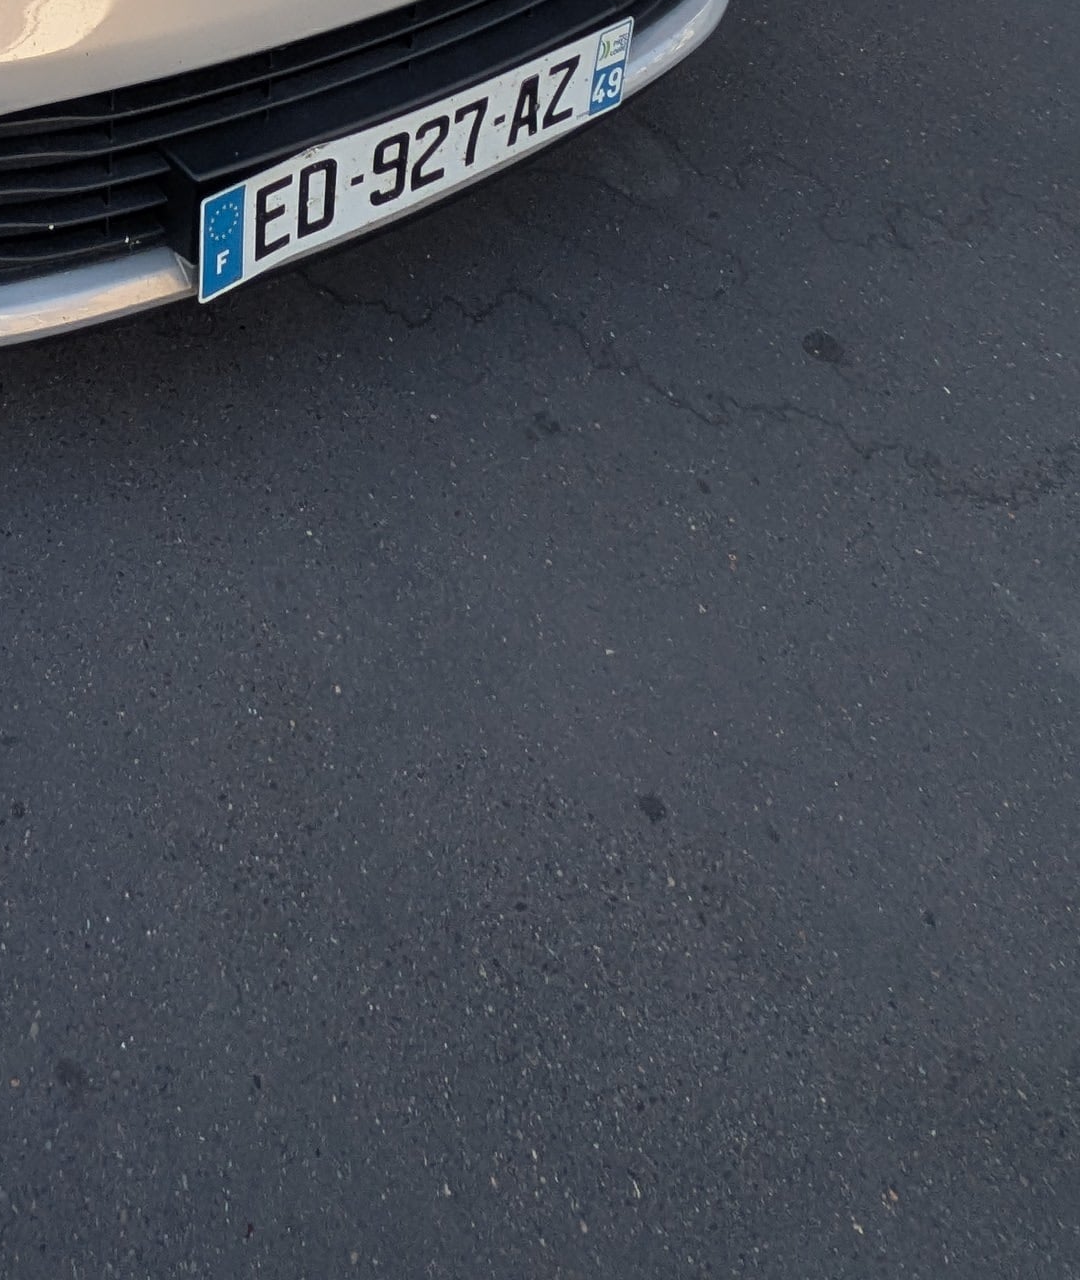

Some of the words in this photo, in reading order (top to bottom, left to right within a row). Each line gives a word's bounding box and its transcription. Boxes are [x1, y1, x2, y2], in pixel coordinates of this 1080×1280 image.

[592, 66, 623, 104] 49
[255, 55, 581, 262] ED-927-AZ
[216, 249, 230, 275] F
